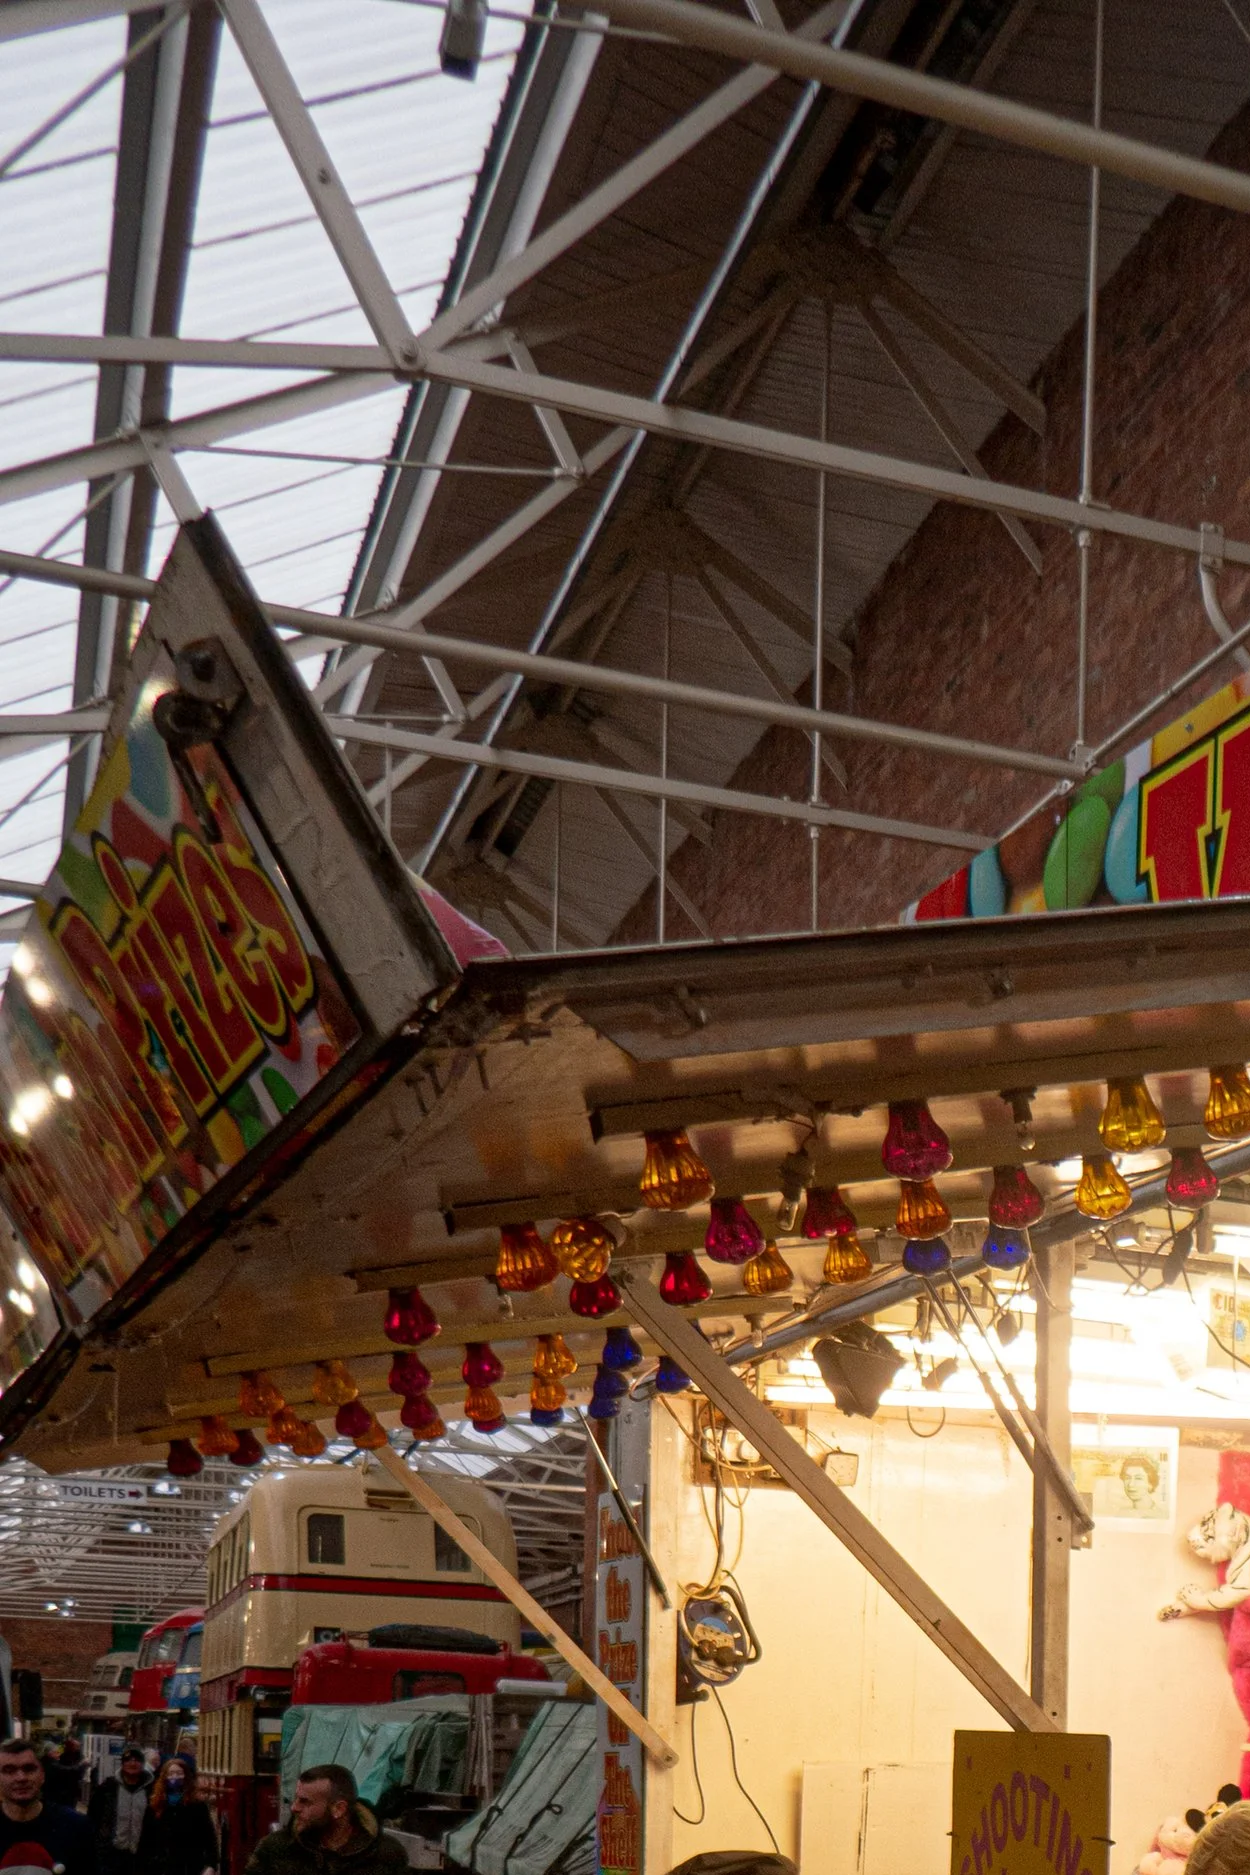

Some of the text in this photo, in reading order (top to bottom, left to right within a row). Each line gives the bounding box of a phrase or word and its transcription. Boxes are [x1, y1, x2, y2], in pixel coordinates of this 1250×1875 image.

[48, 780, 317, 1148] Prizes
[60, 1485, 126, 1499] TOILETS
[606, 1565, 631, 1625] the
